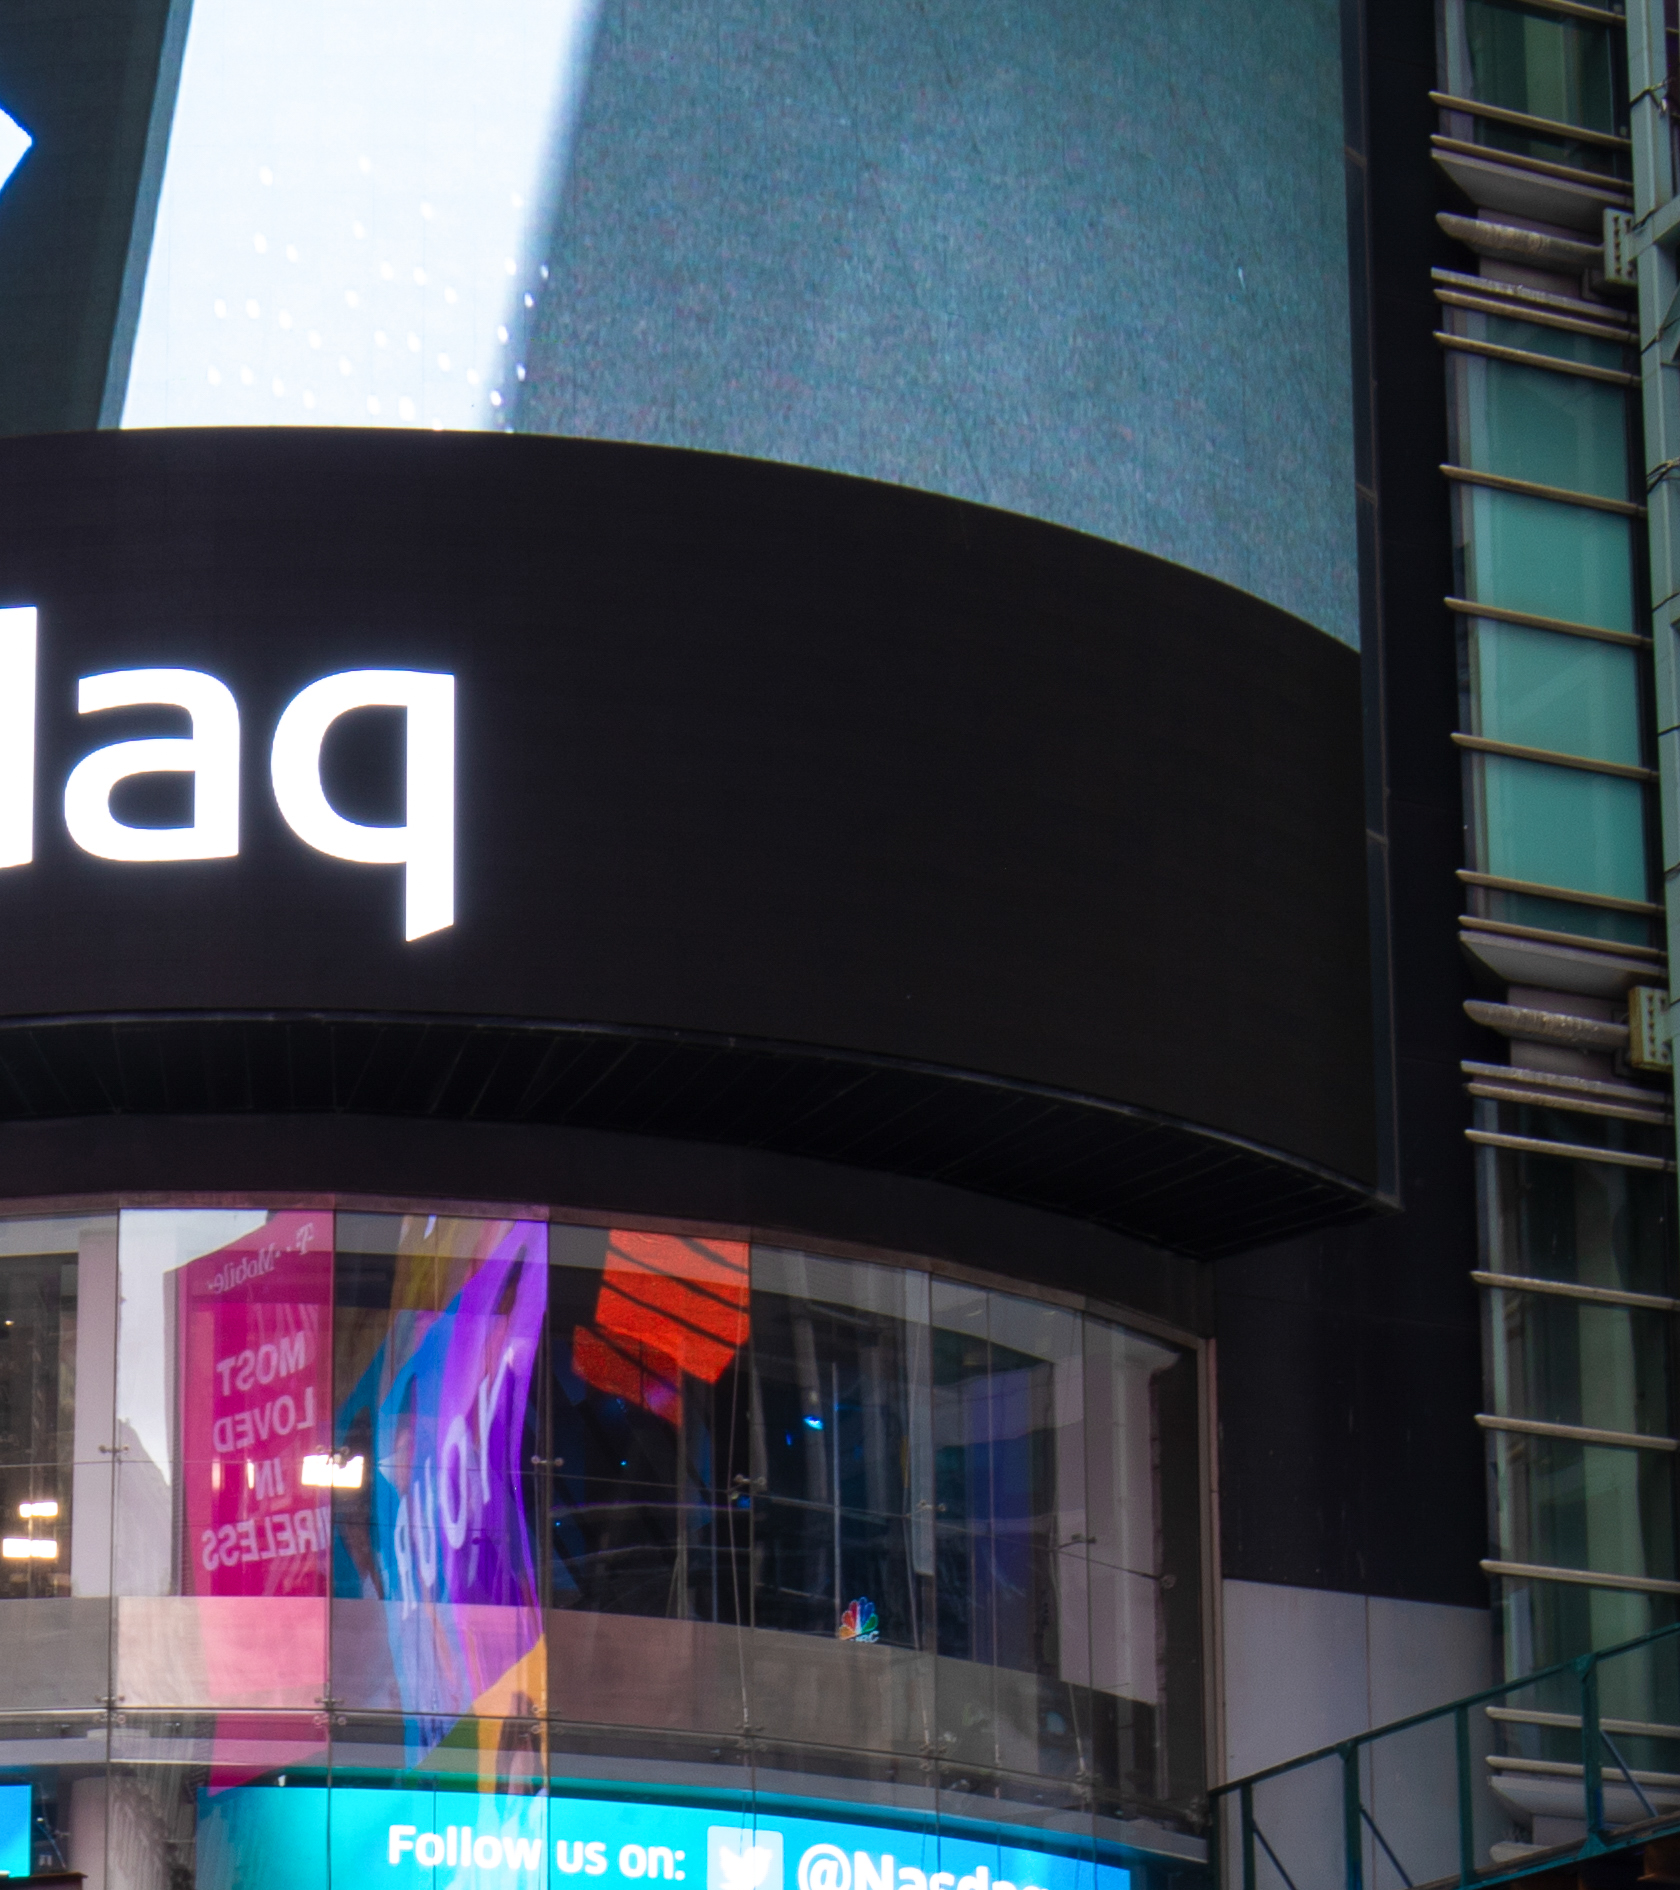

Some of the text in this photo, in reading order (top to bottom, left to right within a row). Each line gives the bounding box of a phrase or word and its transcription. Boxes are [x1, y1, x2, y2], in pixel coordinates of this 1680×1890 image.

[387, 1822, 543, 1872] Follow
[557, 1842, 610, 1878] us
[618, 1837, 687, 1884] on:
